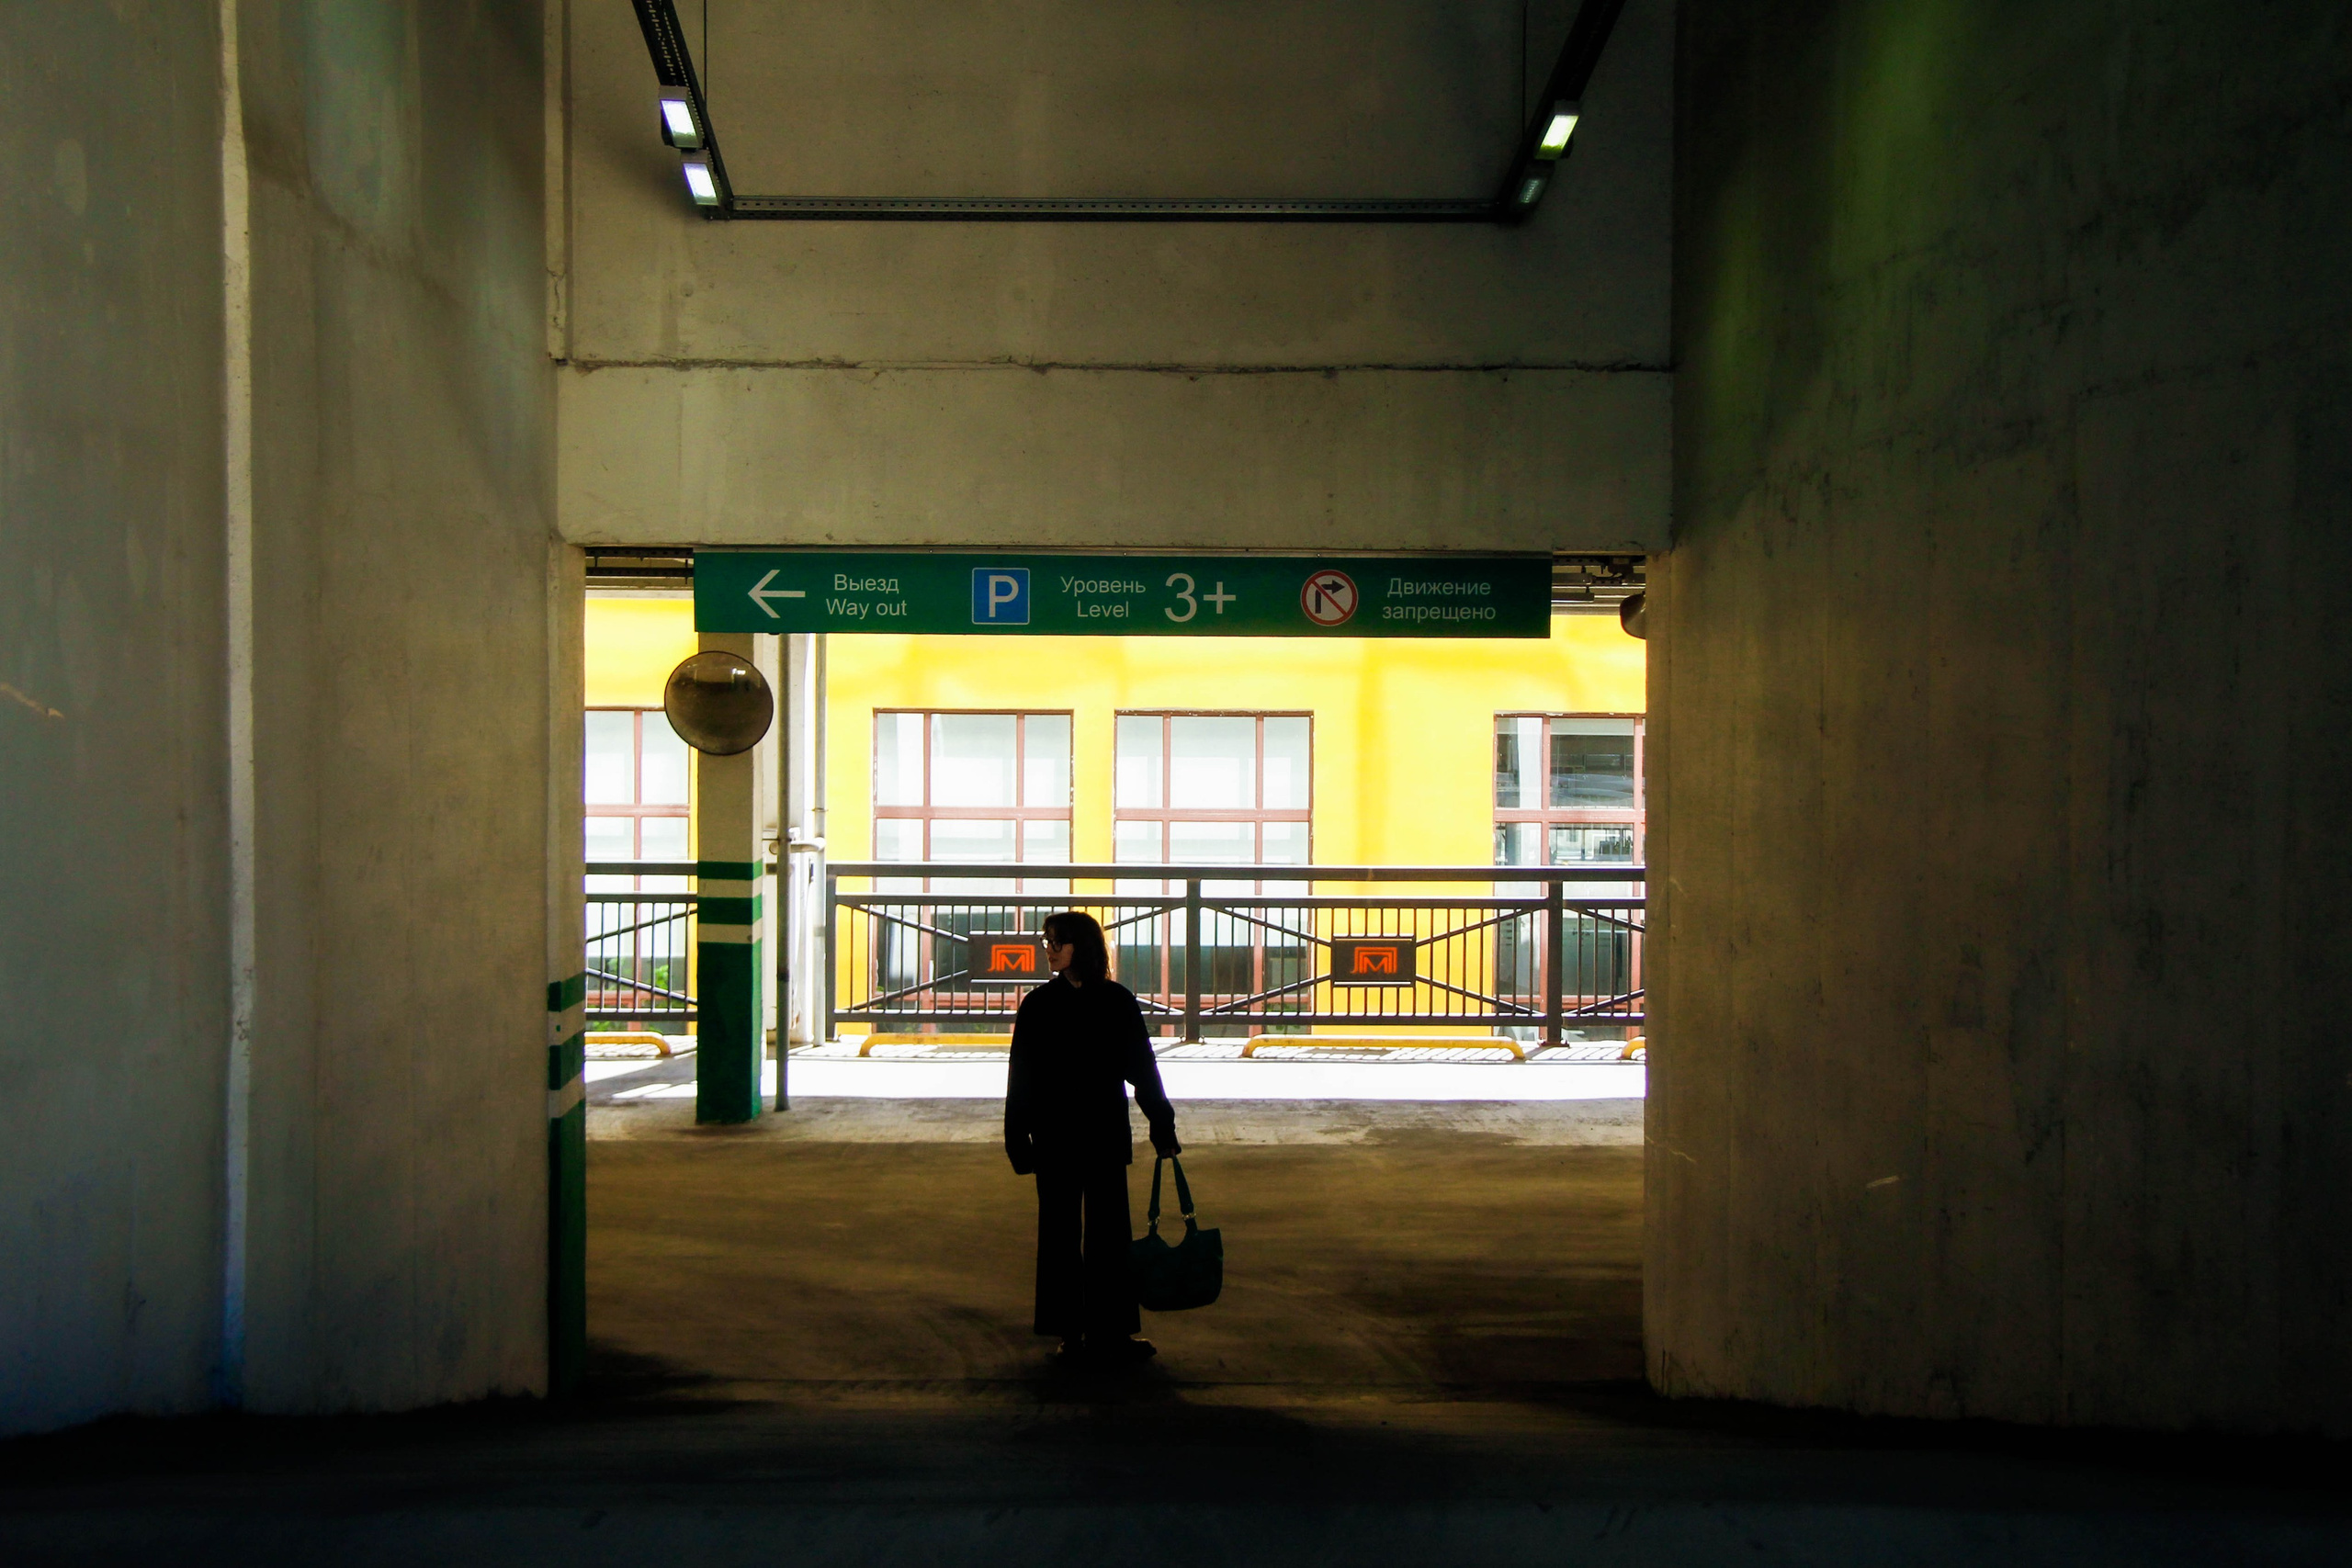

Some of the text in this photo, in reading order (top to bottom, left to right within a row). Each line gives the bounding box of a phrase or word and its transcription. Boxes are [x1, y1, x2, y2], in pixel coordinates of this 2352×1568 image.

[833, 573, 899, 593] Выезд
[1060, 576, 1147, 596] Уровень
[1386, 577, 1492, 598] Движение
[989, 575, 1020, 618] P
[1163, 572, 1237, 623] 3+
[826, 598, 908, 620] Way out
[1077, 600, 1130, 618] Level
[1382, 605, 1498, 623] запрещено
